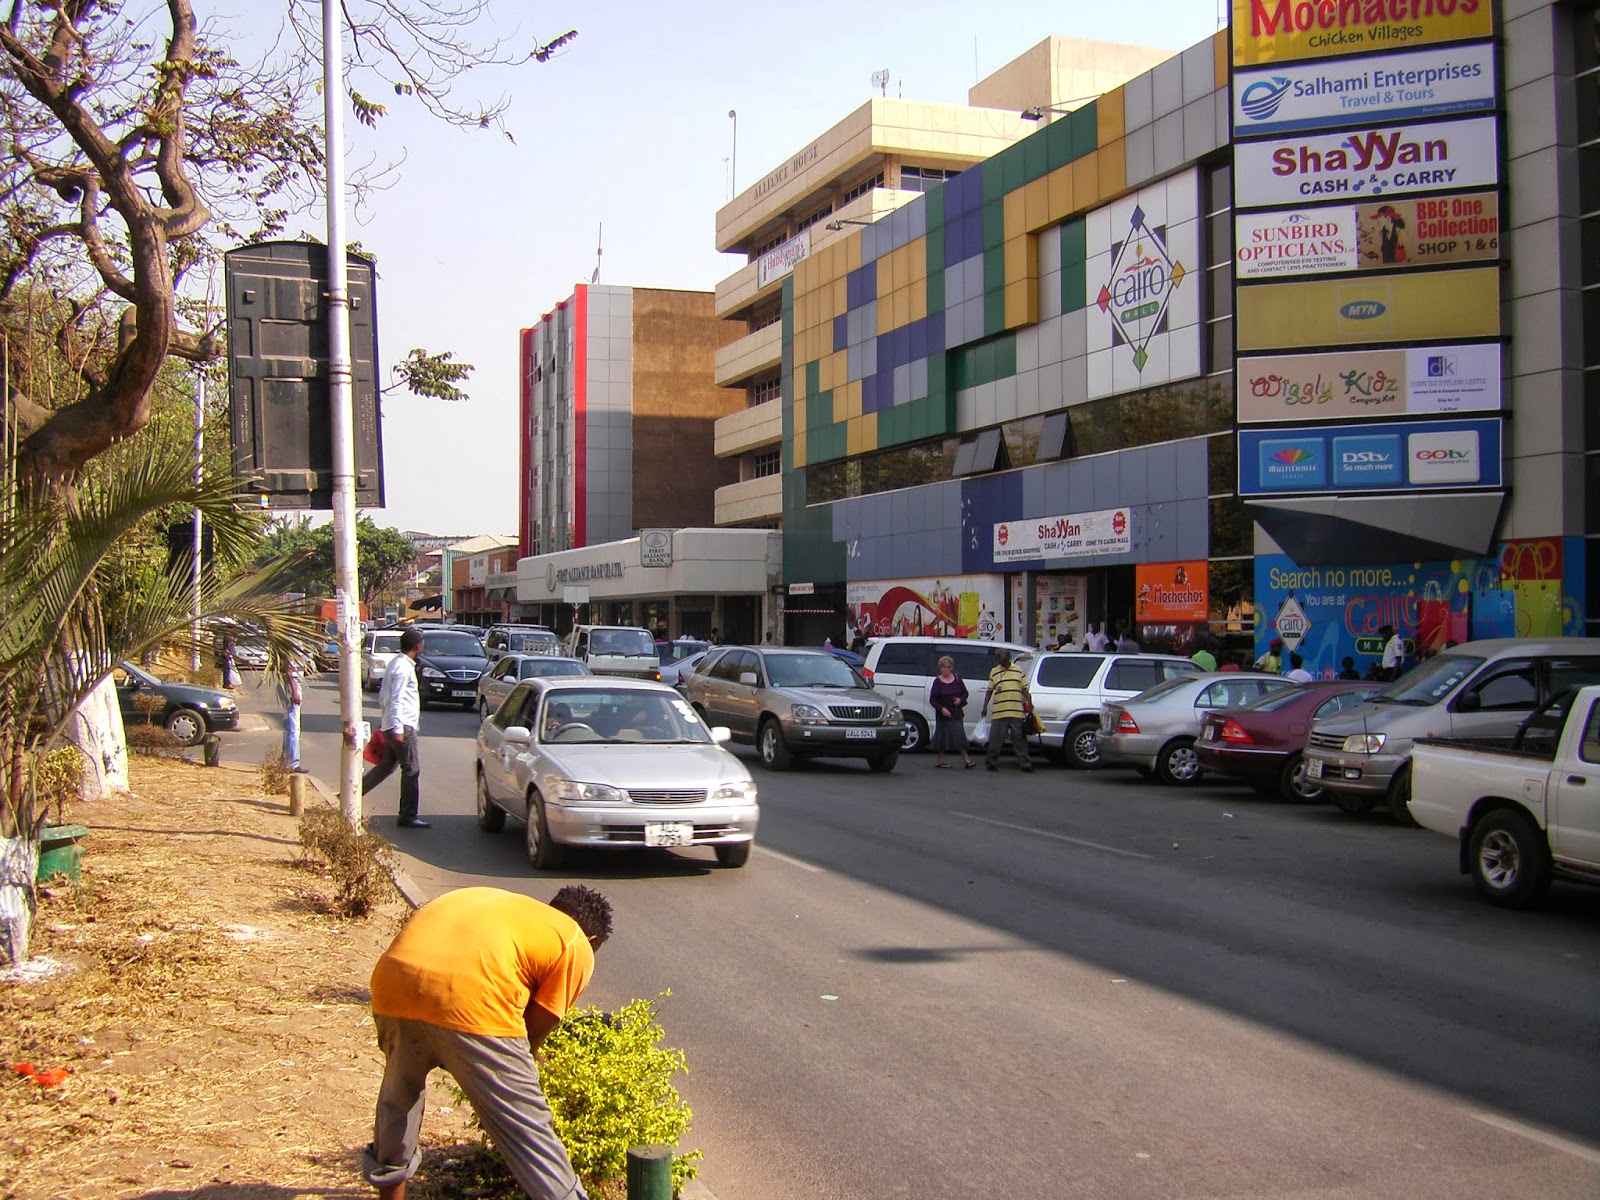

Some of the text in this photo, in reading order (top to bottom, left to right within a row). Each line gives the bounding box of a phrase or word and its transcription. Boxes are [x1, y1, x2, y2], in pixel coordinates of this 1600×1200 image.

[1309, 25, 1423, 48] Chicken Villages
[1293, 62, 1482, 97] Salhami Enterprises
[1340, 88, 1434, 108] Travel & Tours
[754, 145, 818, 200] ALLIANCE HOUSE
[1300, 169, 1456, 195] CASH & CARRY
[1416, 198, 1483, 220] BBC One
[1252, 223, 1339, 243] SUNBIRD
[1417, 217, 1497, 239] Collection
[1238, 239, 1345, 261] OPTICIANS
[1418, 238, 1497, 255] SHOP 1 & 6
[1258, 259, 1300, 267] COMPUTERISED
[1302, 262, 1346, 270] PRACTITIONERS
[1125, 304, 1155, 319] MALL
[1349, 304, 1377, 316] MTN
[1430, 357, 1455, 375] dk
[1250, 370, 1399, 406] Wiggly Kidz
[1350, 395, 1381, 405] Company
[1342, 452, 1390, 464] DStv
[1416, 450, 1469, 460] GOtv
[1343, 463, 1394, 472] So much more
[1044, 542, 1056, 550] CASH
[1066, 540, 1082, 548] CARRY
[1270, 566, 1407, 589] Search no more...
[1154, 583, 1203, 605] Mochachos
[1305, 594, 1345, 606] You are at
